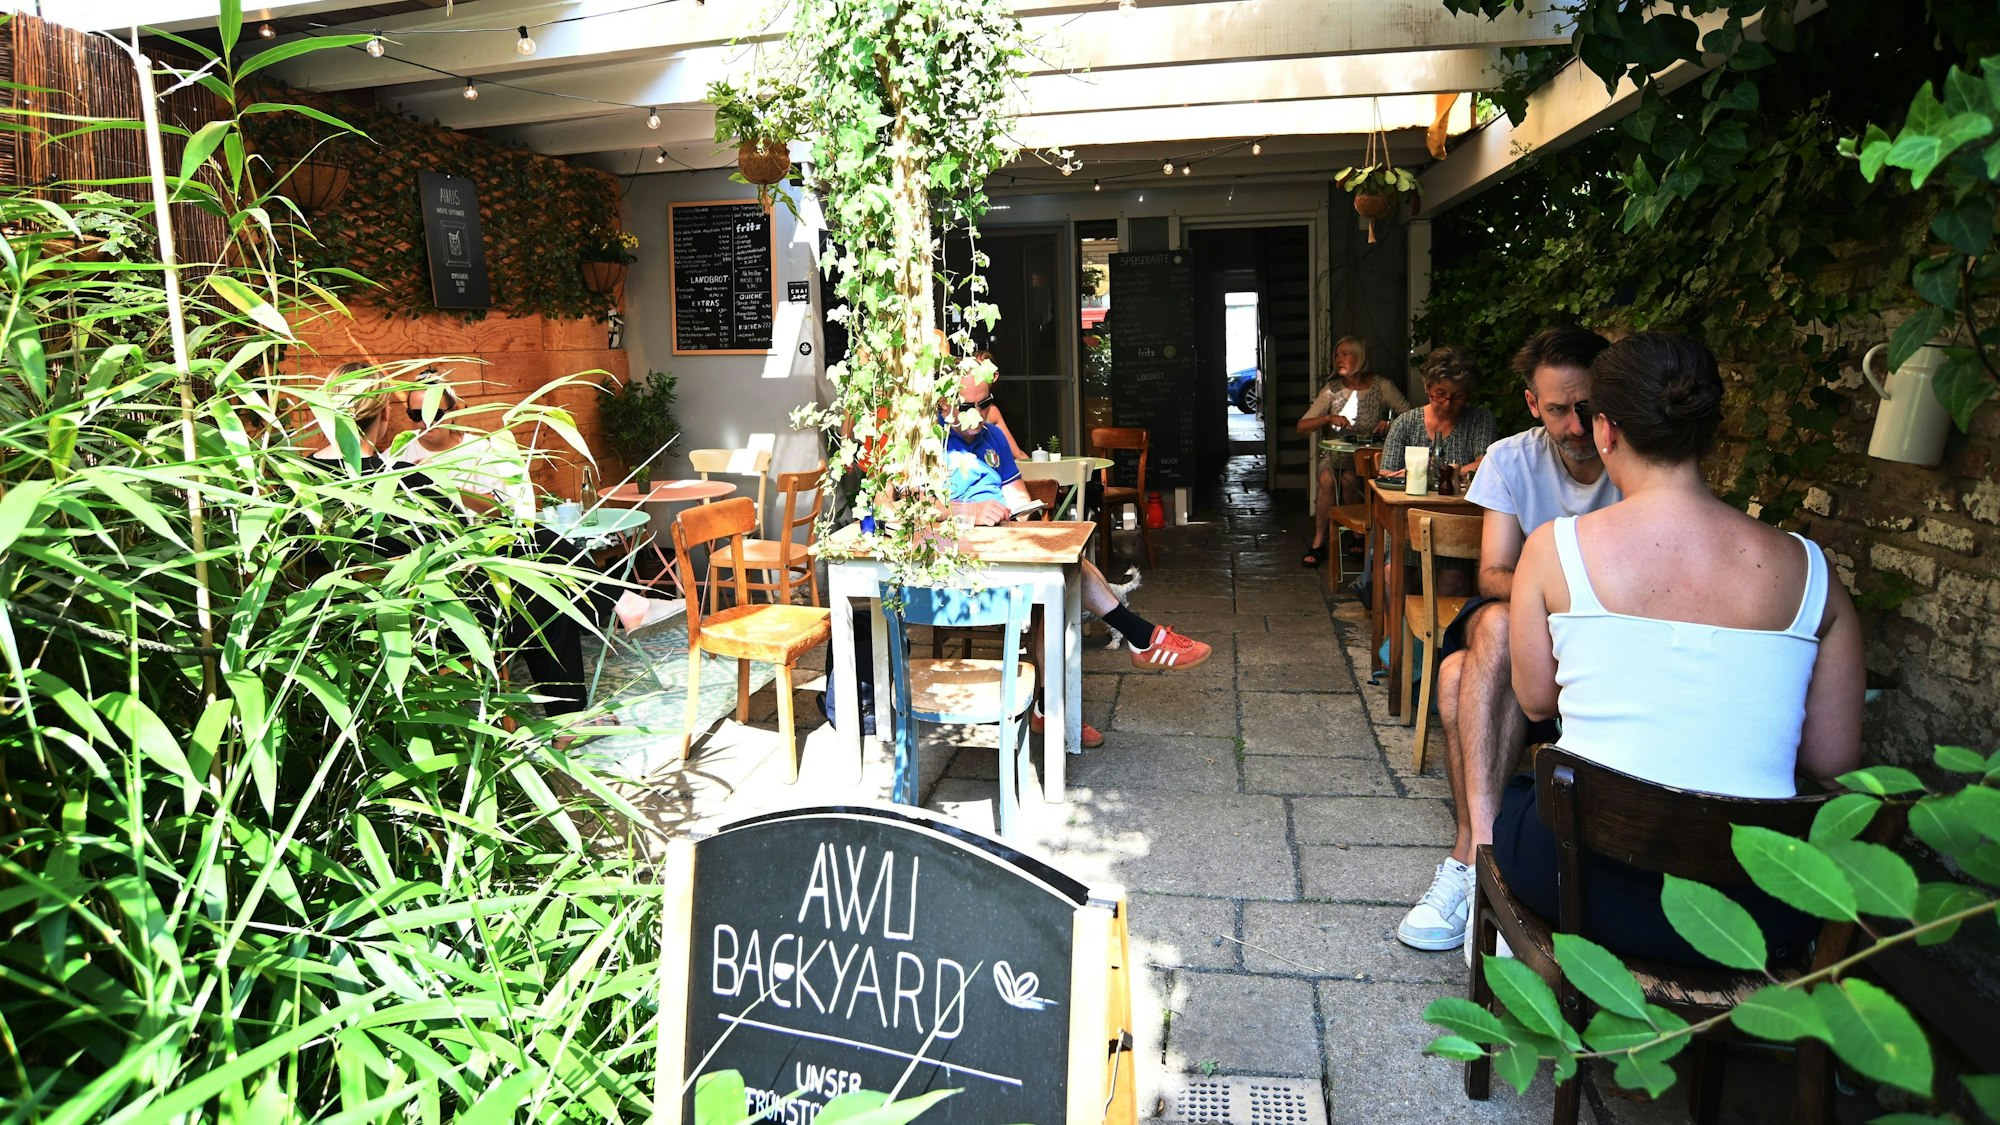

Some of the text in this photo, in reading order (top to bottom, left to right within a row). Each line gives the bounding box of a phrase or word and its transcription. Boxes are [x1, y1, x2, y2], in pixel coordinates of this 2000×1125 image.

[736, 222, 761, 233] fritz
[1119, 254, 1168, 267] SPEISEKARTE
[690, 275, 729, 284] LANDBROT
[691, 299, 720, 307] EXTRAS
[1137, 347, 1155, 358] fritz
[797, 842, 919, 941] AWU
[712, 923, 966, 1039] BACKYARD
[796, 1061, 862, 1099] UNSER
[744, 1086, 824, 1125] FRÜHSTÜ
